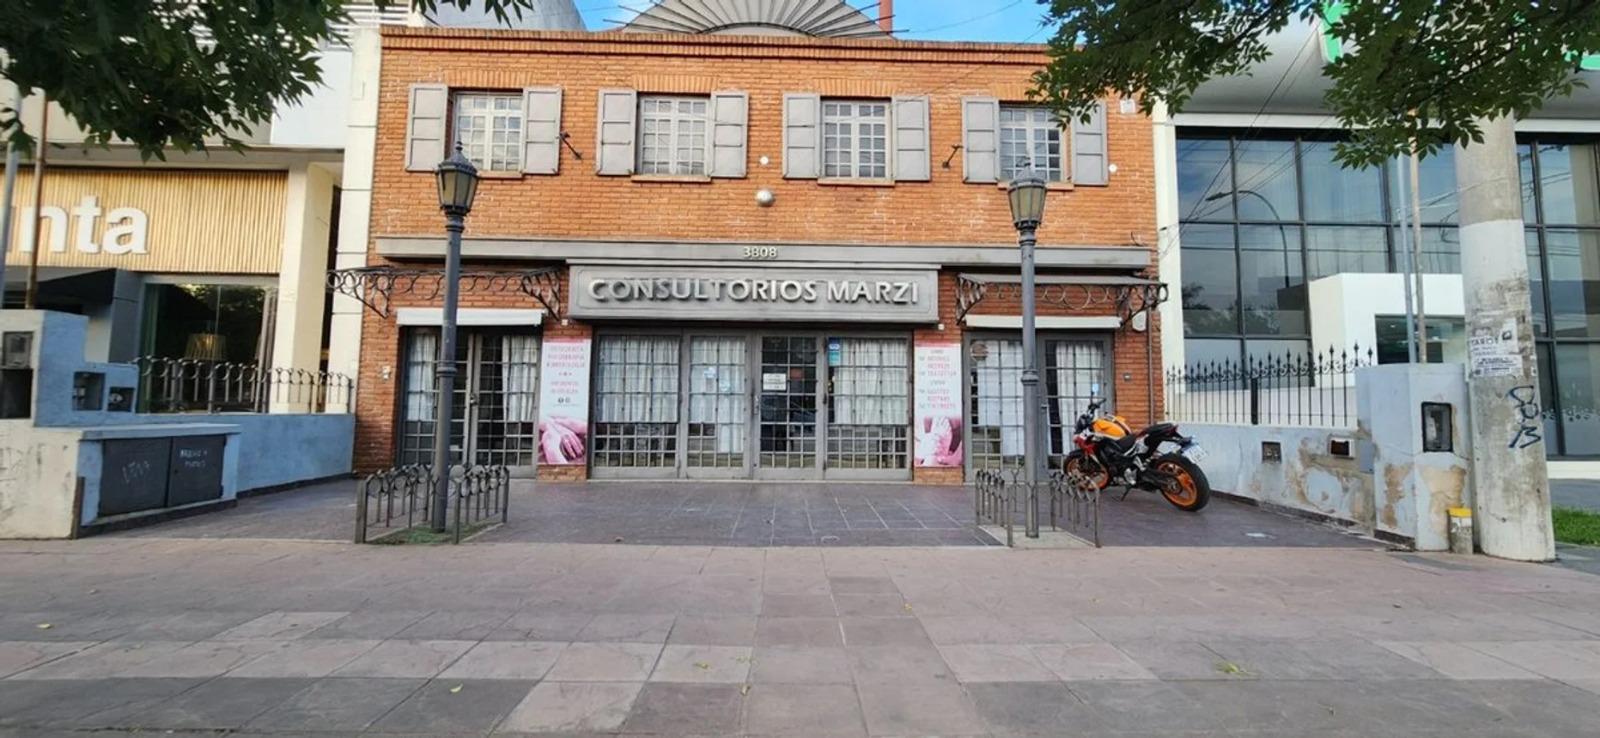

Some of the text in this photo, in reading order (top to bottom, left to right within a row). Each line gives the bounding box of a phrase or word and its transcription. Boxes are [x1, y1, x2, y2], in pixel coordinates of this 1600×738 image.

[0, 195, 148, 254] nta
[743, 246, 777, 258] 3808
[588, 277, 919, 305] CONSULTORIOS MARZI
